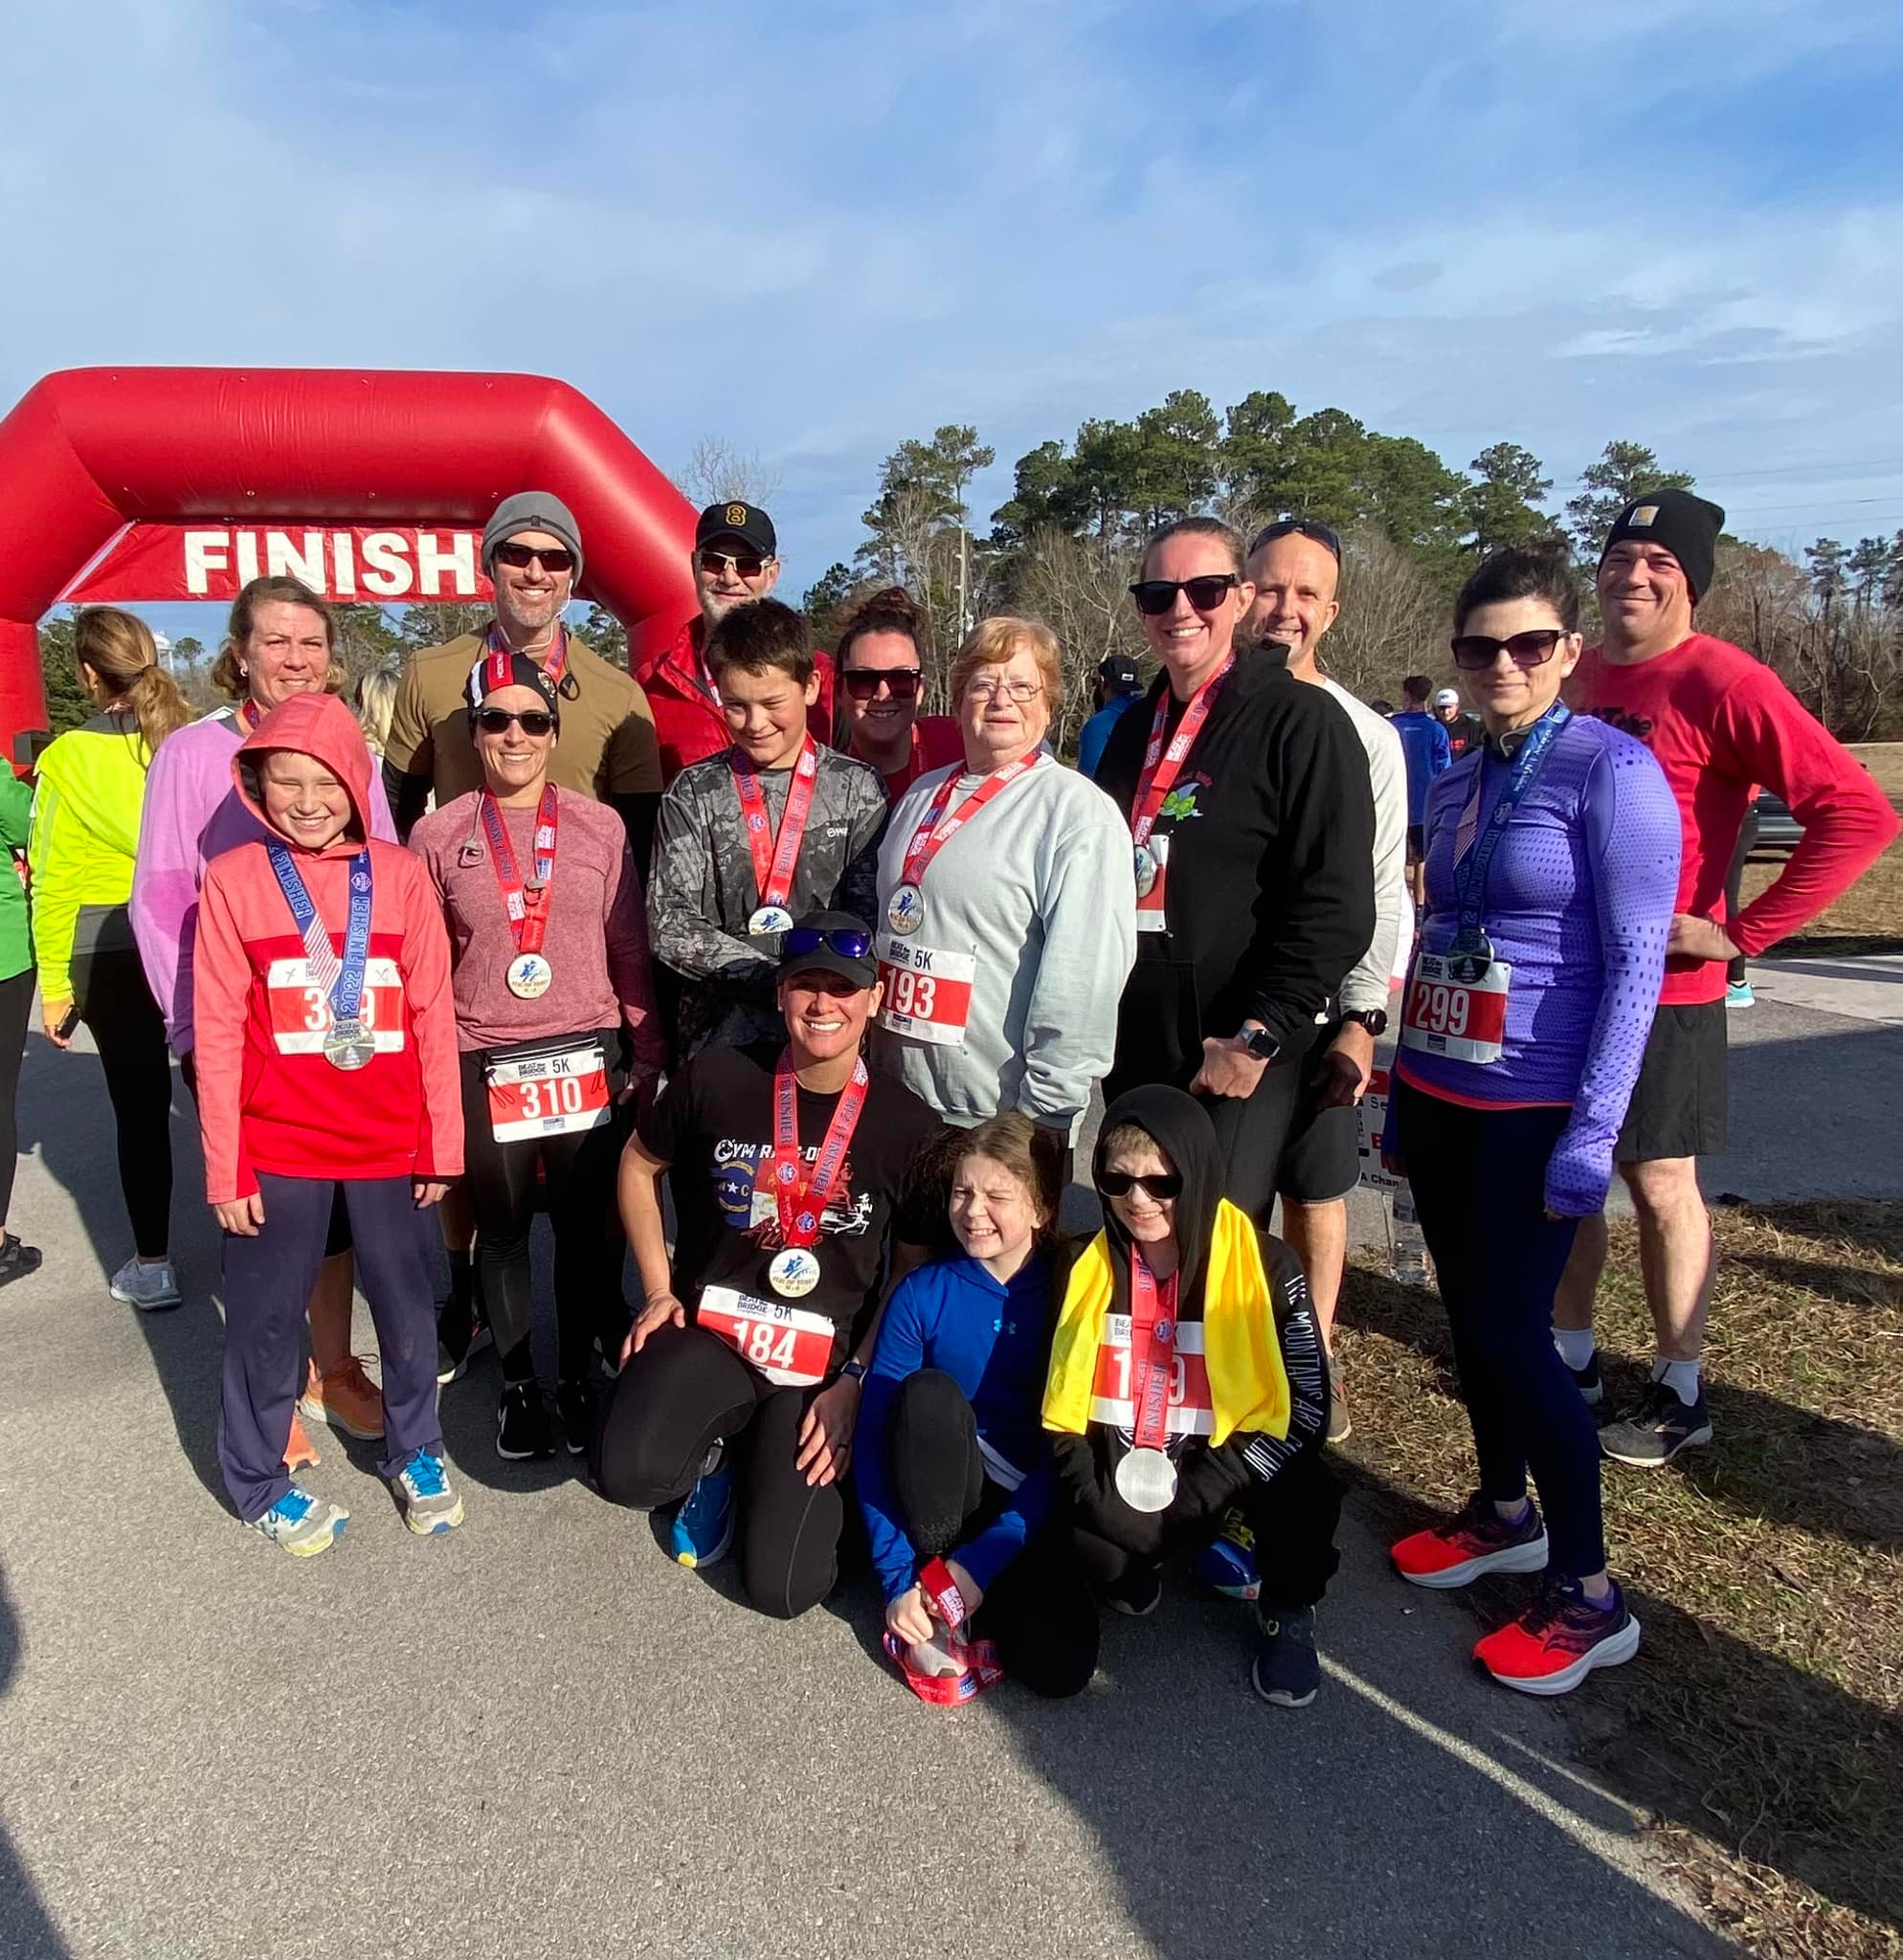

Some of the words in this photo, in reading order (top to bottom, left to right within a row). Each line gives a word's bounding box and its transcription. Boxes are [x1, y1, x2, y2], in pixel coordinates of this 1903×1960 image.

[184, 531, 477, 596] FINISH
[272, 850, 315, 920] FINISHER
[346, 895, 371, 967] FINISHER
[914, 949, 933, 970] 5K
[303, 987, 375, 1032] 39
[340, 969, 364, 1014] 2022
[886, 968, 936, 1019] 193
[1416, 984, 1470, 1036] 299
[552, 1058, 571, 1074] 5K
[520, 1078, 583, 1120] 310
[1371, 1174, 1399, 1188] Chan
[736, 1301, 767, 1313] BRIDGE
[773, 1303, 793, 1321] 5K
[732, 1320, 797, 1370] 184
[1284, 1310, 1324, 1401] MOUNTAINS
[1113, 1349, 1186, 1407] 19
[1143, 1362, 1167, 1441] FINISHER
